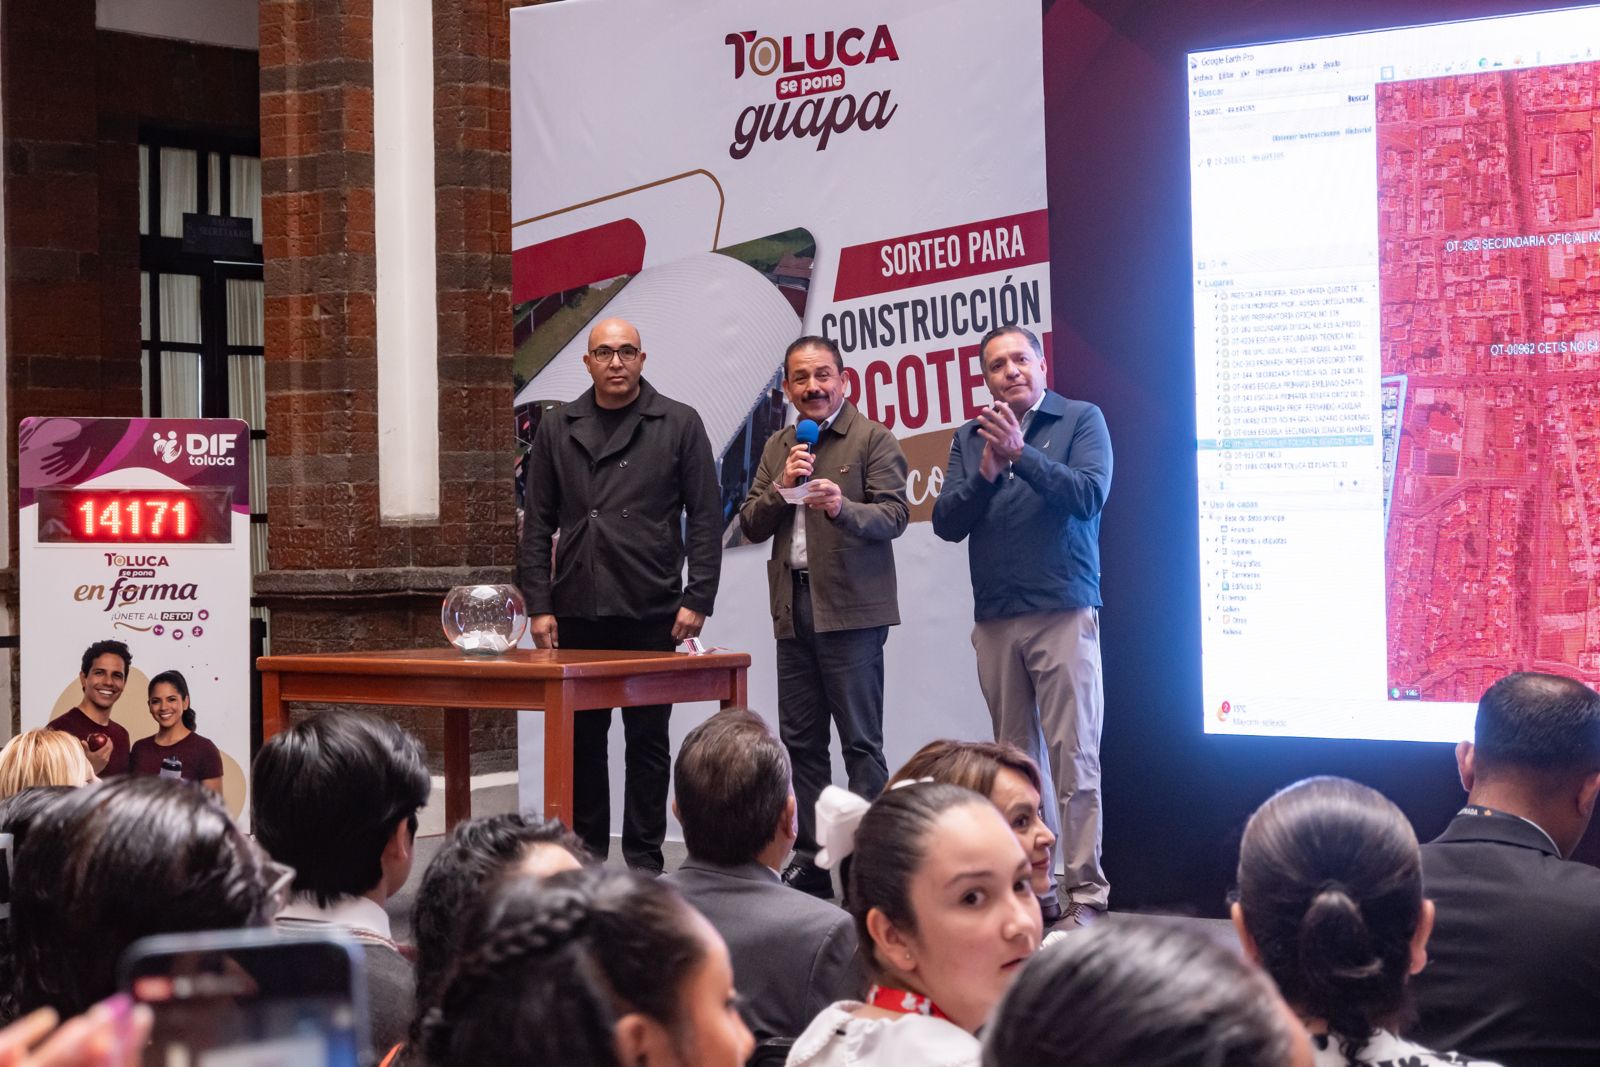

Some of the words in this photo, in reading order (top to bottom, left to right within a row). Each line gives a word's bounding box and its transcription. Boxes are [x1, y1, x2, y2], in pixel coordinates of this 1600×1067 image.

[725, 24, 899, 79] TOLUCA
[1201, 57, 1225, 66] Google
[1226, 54, 1242, 64] Earth
[1243, 53, 1254, 61] Pro
[780, 79, 798, 95] se
[801, 72, 842, 95] pone
[1199, 88, 1224, 97] Buscar
[1348, 94, 1369, 103] Buscar
[729, 89, 898, 160] guapa
[880, 235, 961, 278] SORTEO
[968, 224, 1026, 264] PARA
[1482, 234, 1546, 251] SECUNDARIA
[1548, 231, 1587, 246] OFICIAL
[821, 275, 1041, 353] CONSTRUCCIÓN
[186, 433, 237, 456] DIF
[189, 454, 235, 466] toluca
[79, 500, 187, 535] 14171
[104, 552, 169, 567] TOLUCA
[132, 570, 154, 578] pone
[74, 582, 104, 602] en
[104, 577, 198, 612] forma
[147, 612, 158, 621] AL
[162, 612, 192, 621] RETO!
